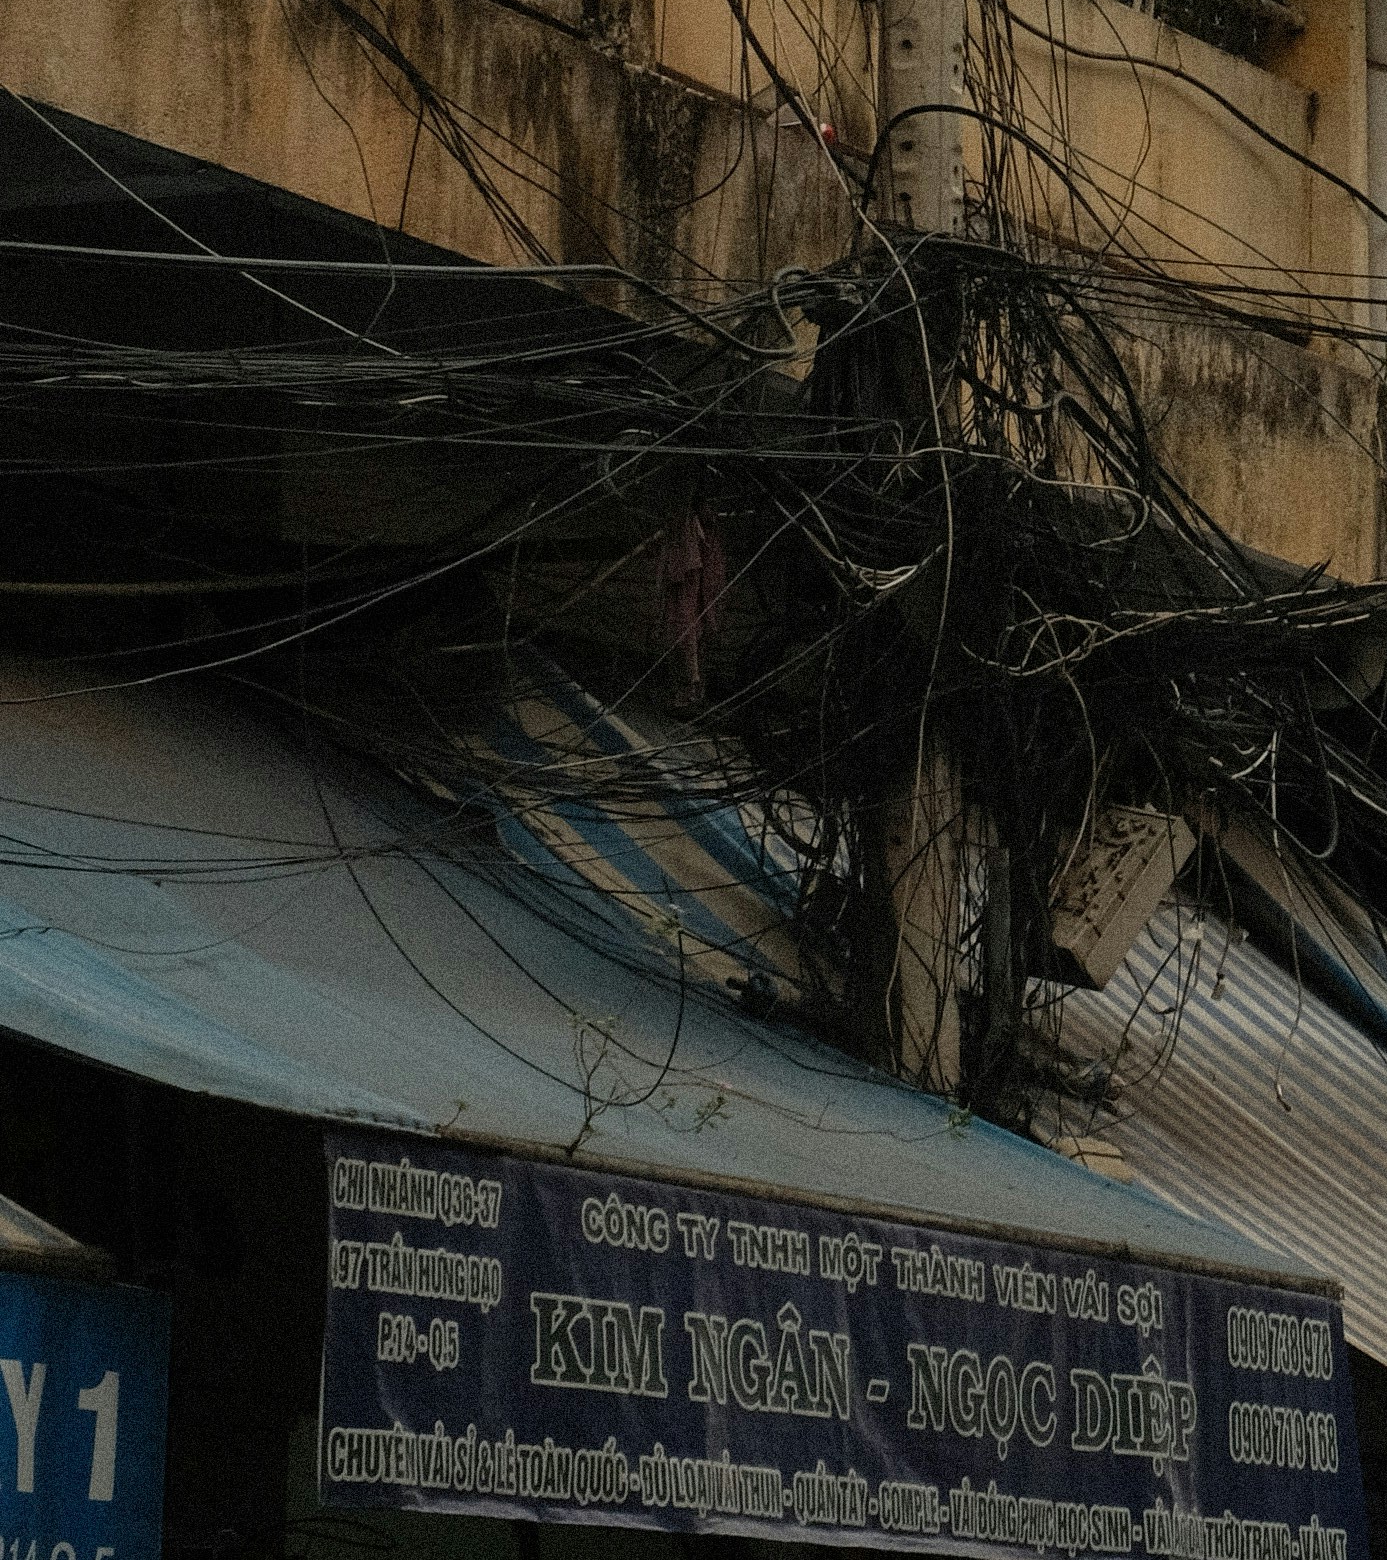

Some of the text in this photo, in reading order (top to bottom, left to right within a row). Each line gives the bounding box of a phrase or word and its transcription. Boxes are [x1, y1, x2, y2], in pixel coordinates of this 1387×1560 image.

[334, 1157, 366, 1210] CHI
[368, 1156, 438, 1220] NHÁNH
[468, 1255, 502, 1314] ĐẠO
[580, 1193, 1163, 1336] CÔNG TY TNHH MỘT THÀNH VIÊN VẢI SỢI
[76, 1370, 121, 1503] 1
[530, 1291, 669, 1399] KIM
[685, 1301, 850, 1420] NGÂN
[906, 1343, 1057, 1461] NGỌC
[1070, 1354, 1198, 1477] DIỆP
[418, 1420, 451, 1489] VẢI
[477, 1440, 493, 1492] &
[517, 1437, 571, 1499] TOÀN
[574, 1436, 629, 1506] QUỐC
[1055, 1501, 1089, 1559] HỌC
[1089, 1504, 1132, 1553] SINH
